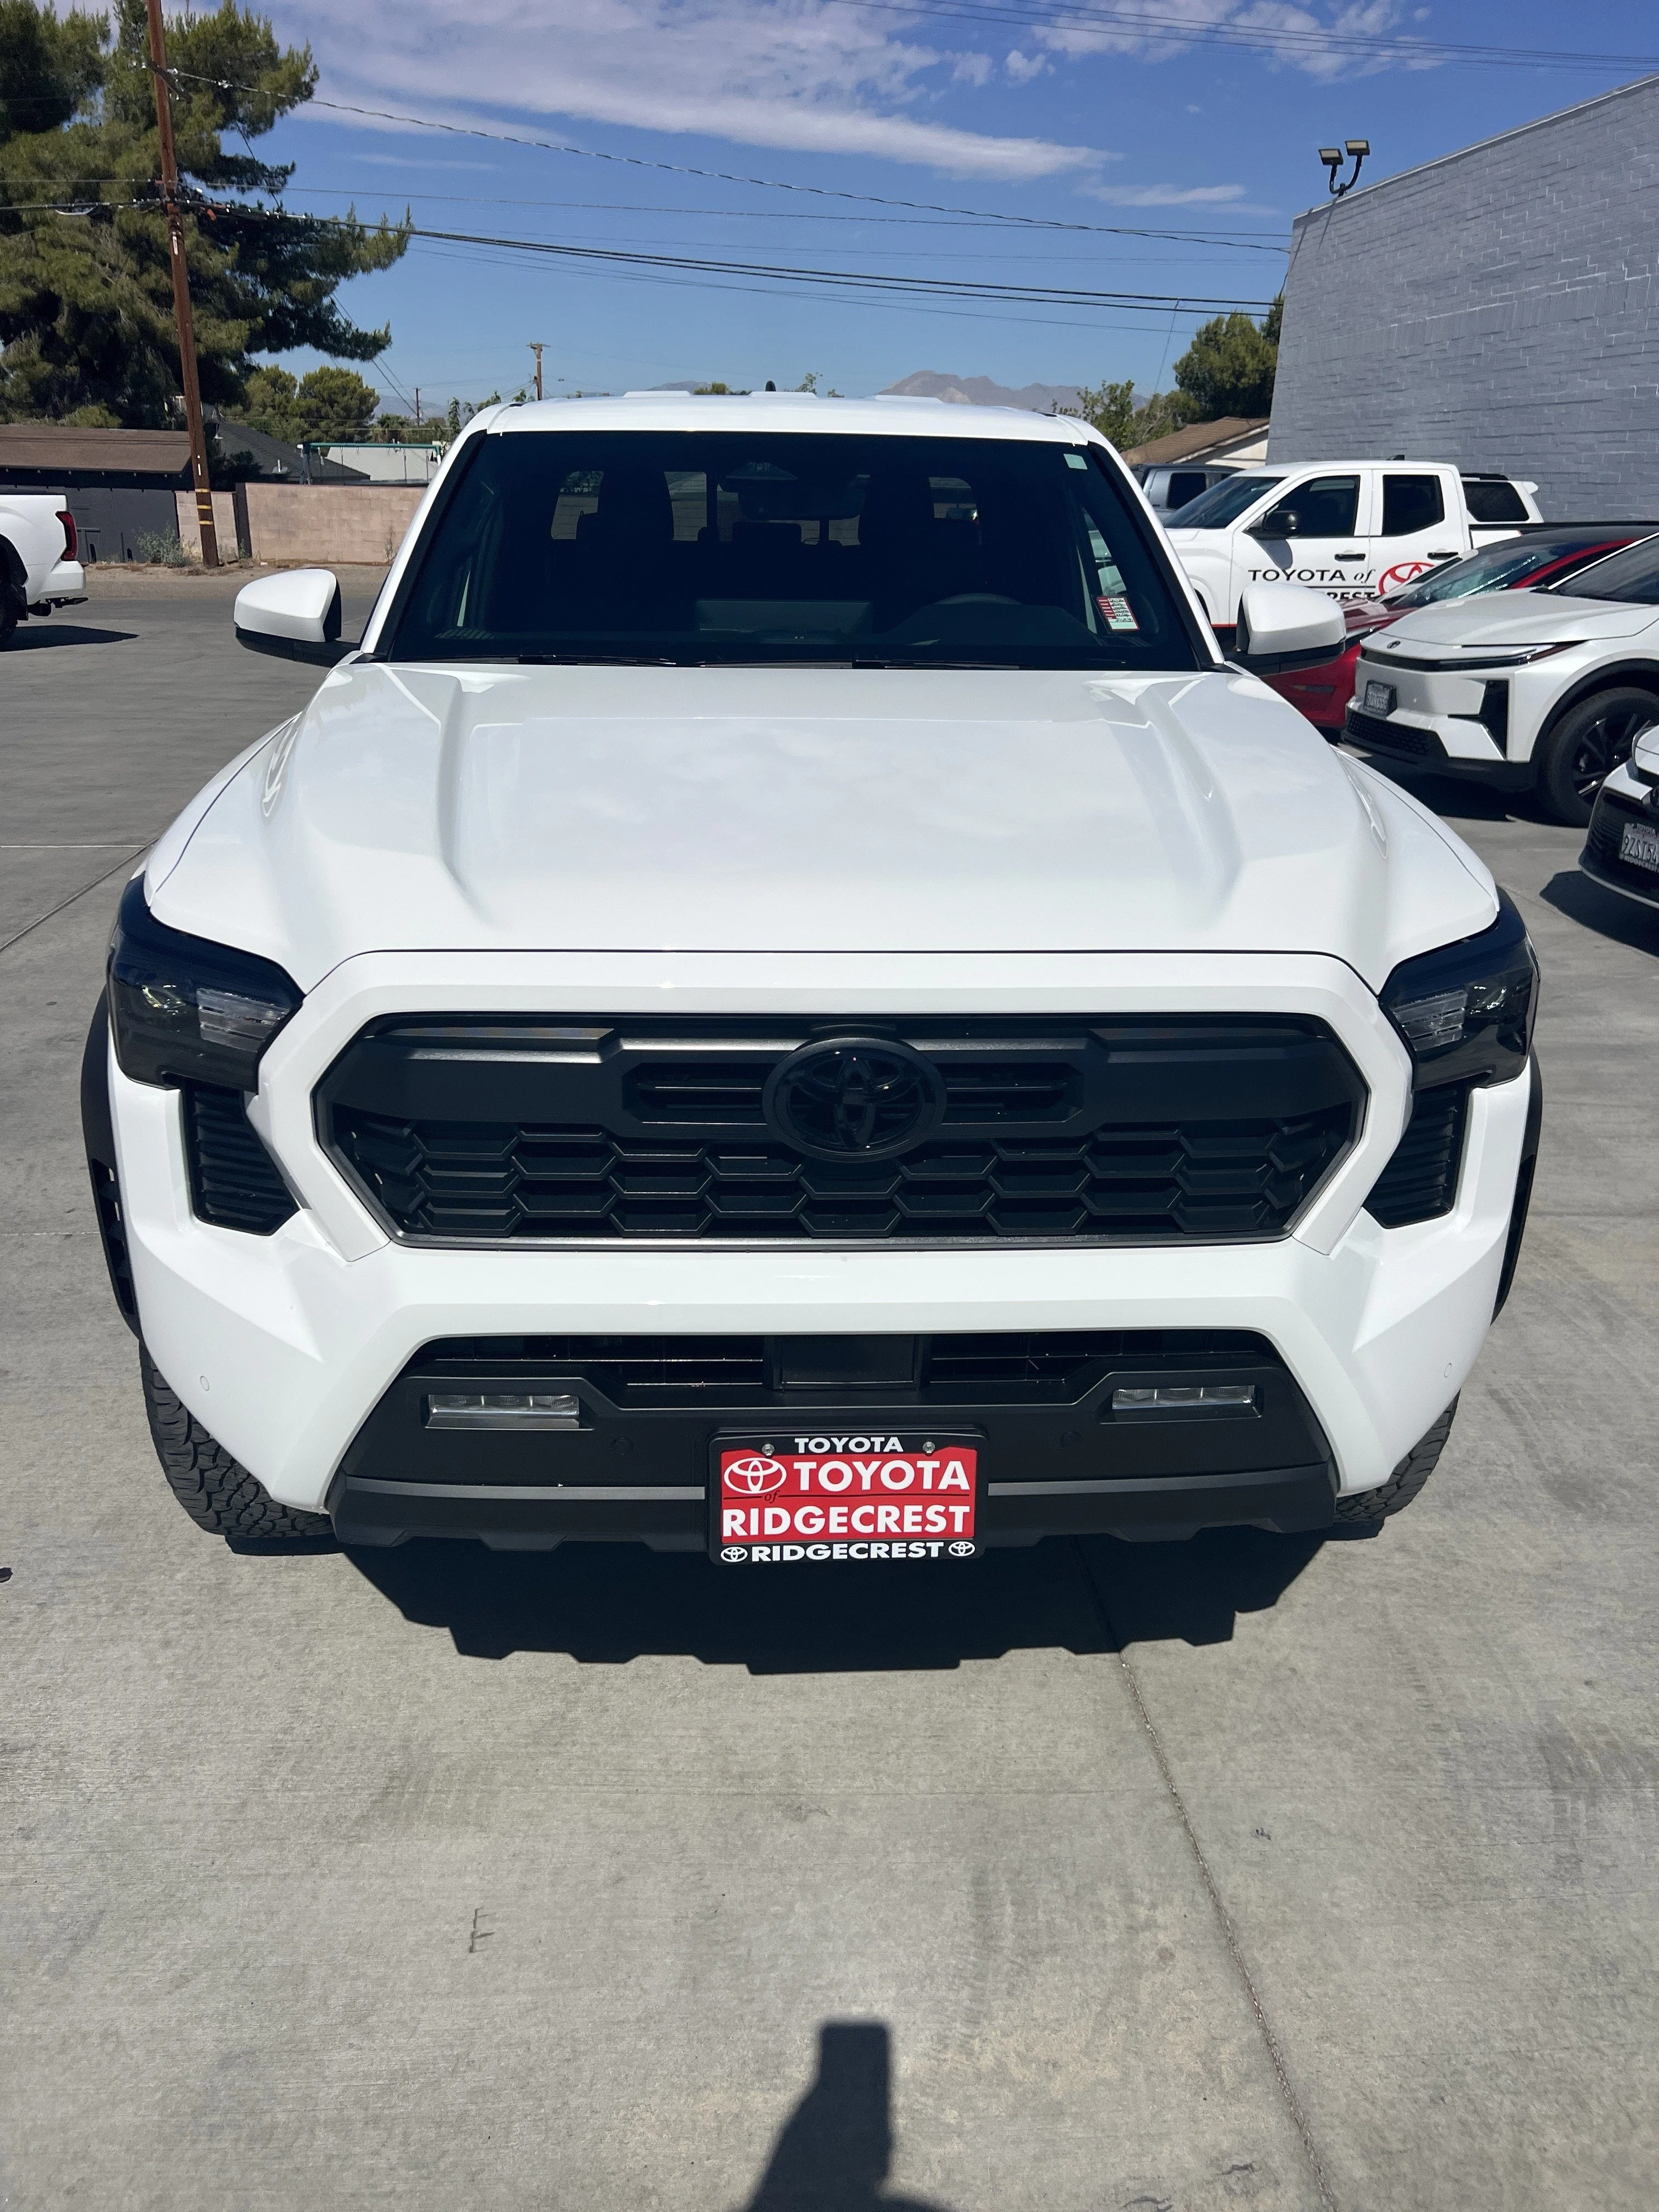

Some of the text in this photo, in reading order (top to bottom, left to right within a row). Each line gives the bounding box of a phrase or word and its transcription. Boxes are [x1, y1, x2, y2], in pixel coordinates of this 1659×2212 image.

[1248, 569, 1376, 584] TOYOTA of
[794, 1436, 904, 1454] TOYOTA
[793, 1459, 971, 1492] TOYOTA
[764, 1490, 780, 1504] of
[723, 1505, 971, 1537] RIDGECREST
[752, 1542, 945, 1562] RIDGECREST
